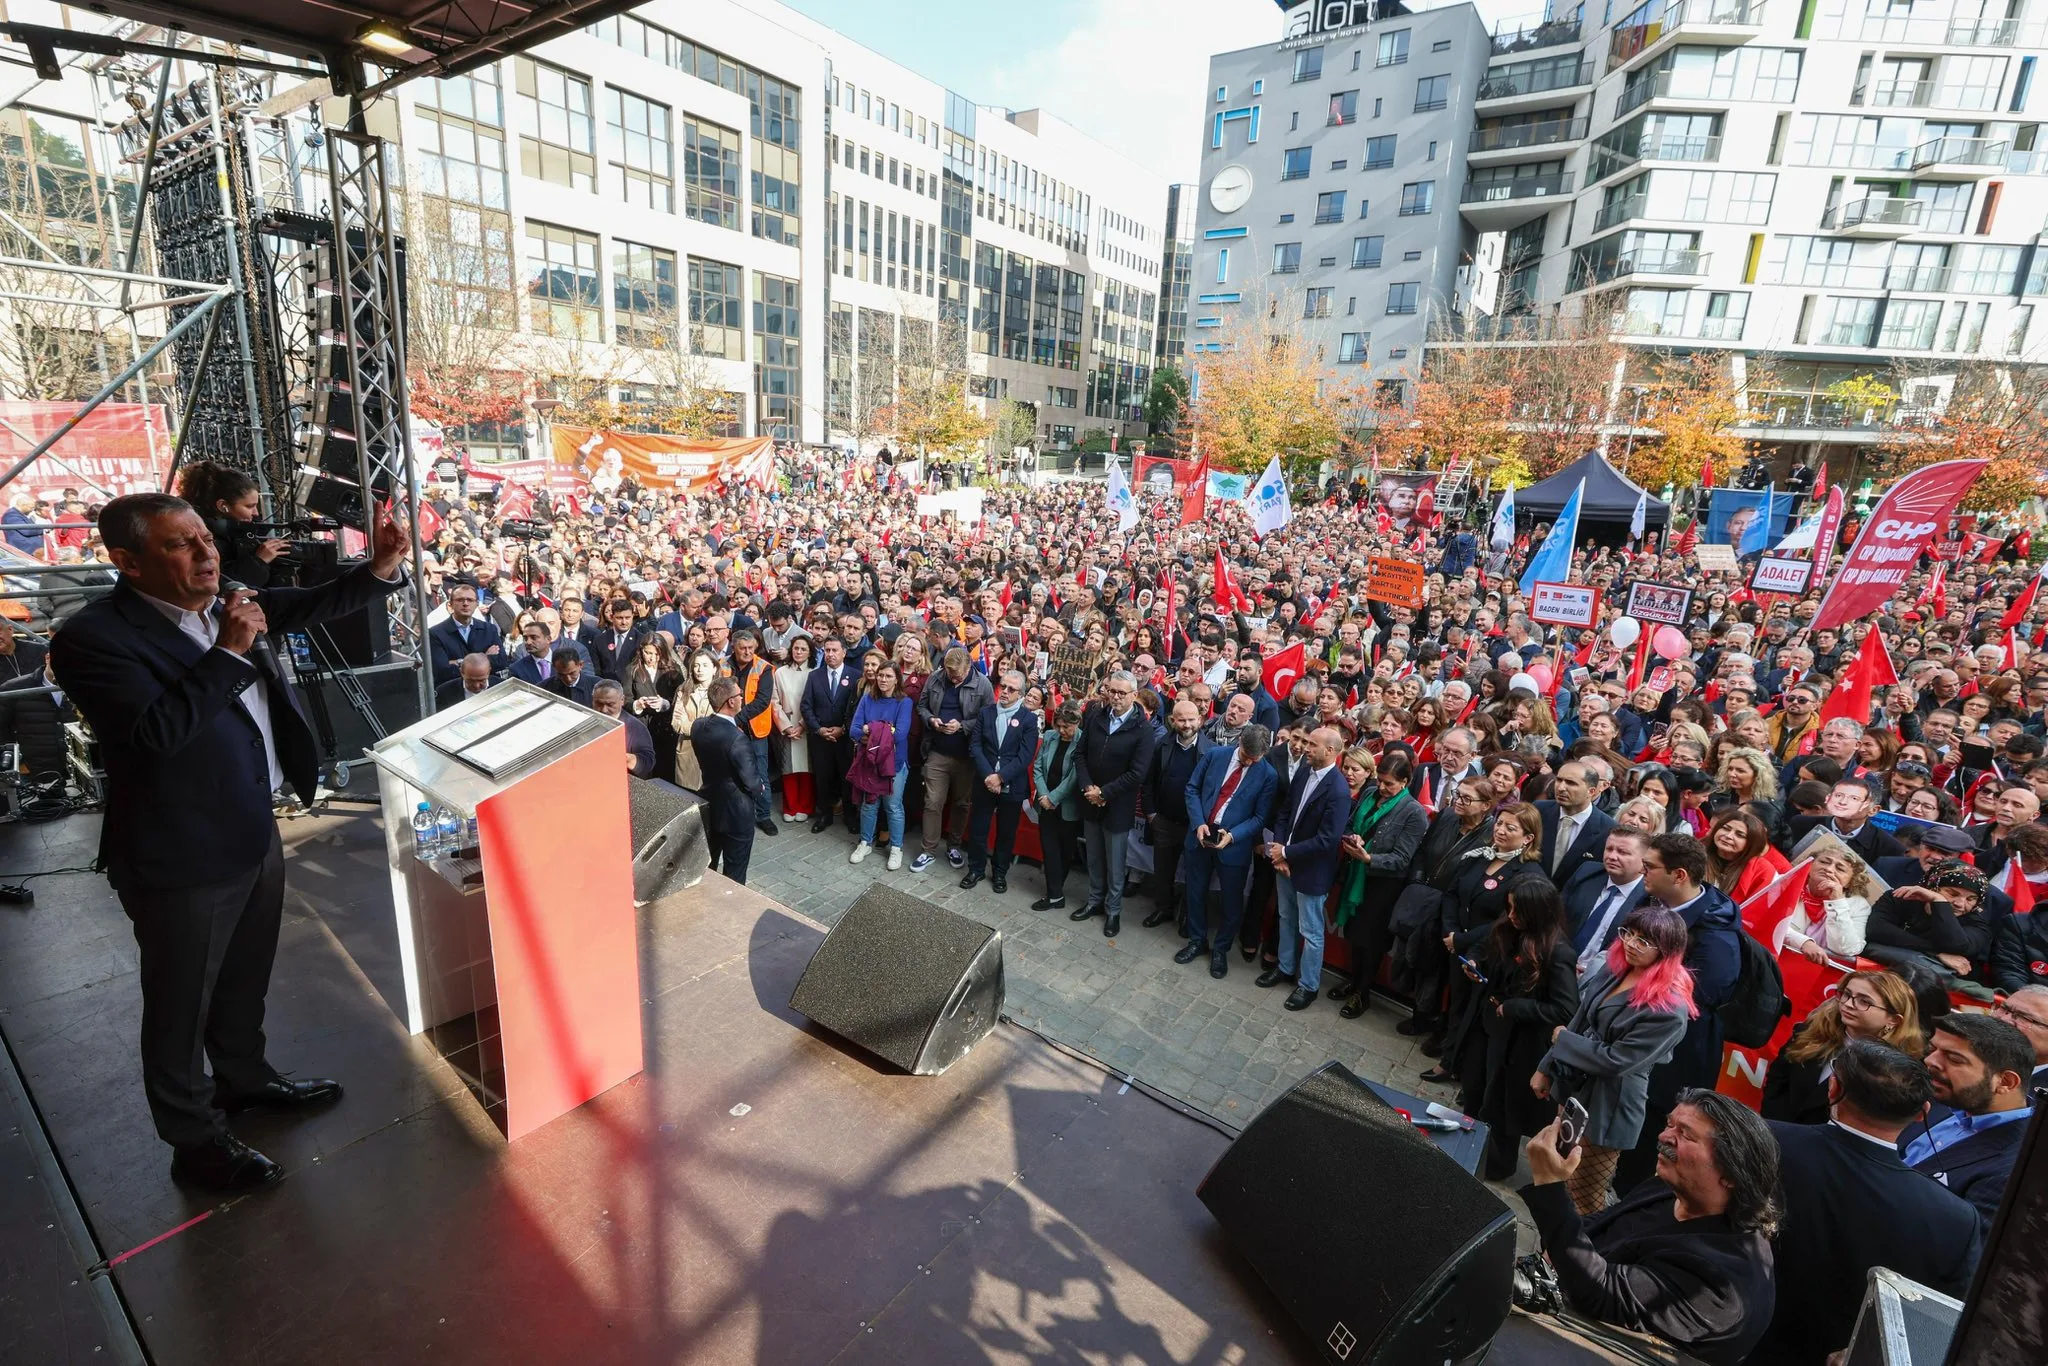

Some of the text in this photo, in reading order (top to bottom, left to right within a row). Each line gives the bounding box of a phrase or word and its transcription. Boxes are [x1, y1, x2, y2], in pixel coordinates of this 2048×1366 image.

[1875, 519, 1937, 541] CHP
[1759, 566, 1806, 583] ADALET
[1538, 604, 1560, 613] BADEN
